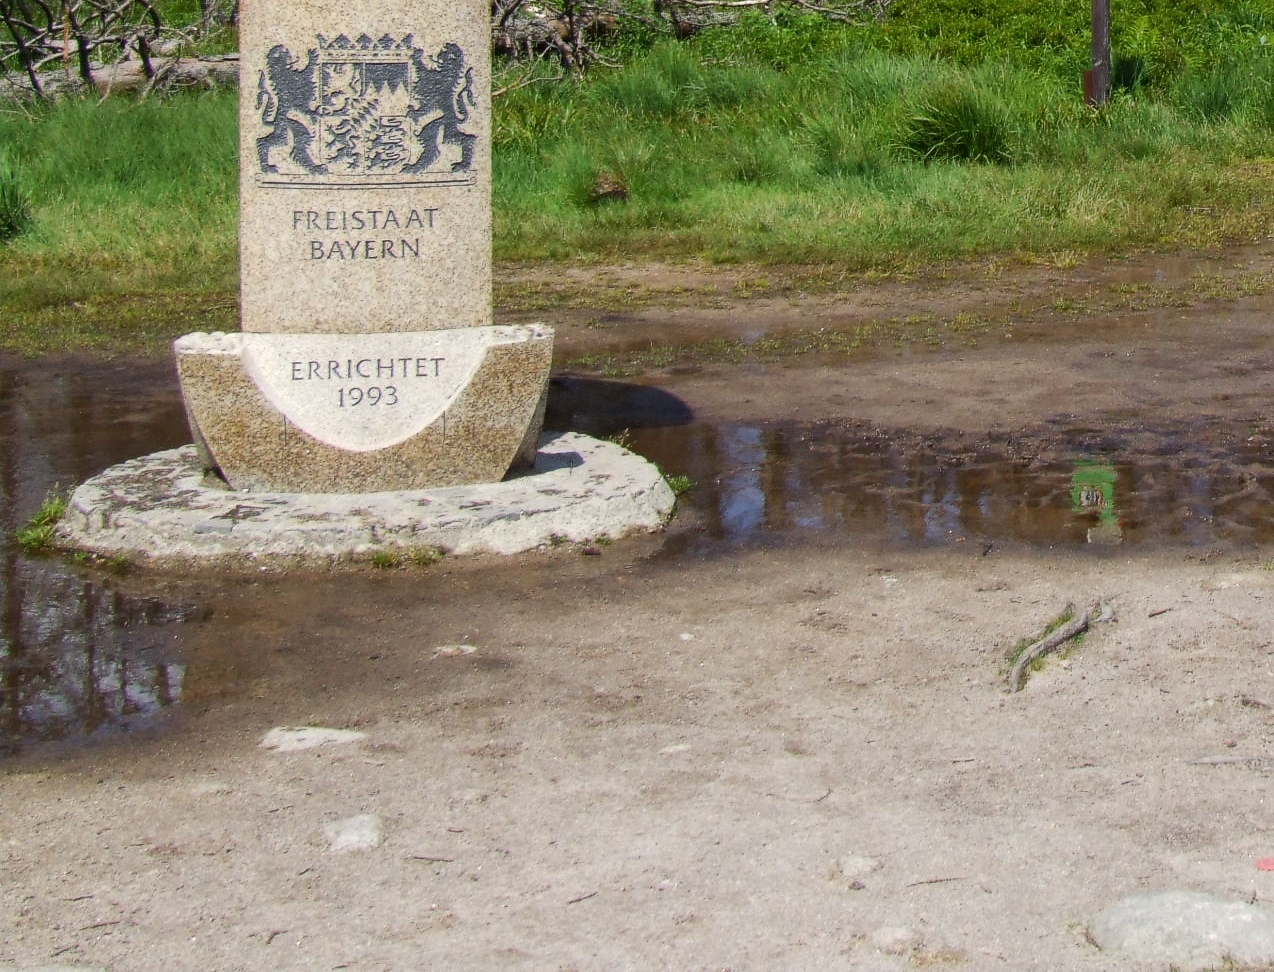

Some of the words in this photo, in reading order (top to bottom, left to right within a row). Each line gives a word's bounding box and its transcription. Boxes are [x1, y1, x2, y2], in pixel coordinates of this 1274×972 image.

[292, 208, 439, 231] FREISTAAT
[310, 238, 420, 260] BAYERN
[291, 357, 446, 381] ERRICHTET
[338, 385, 399, 408] 1993
